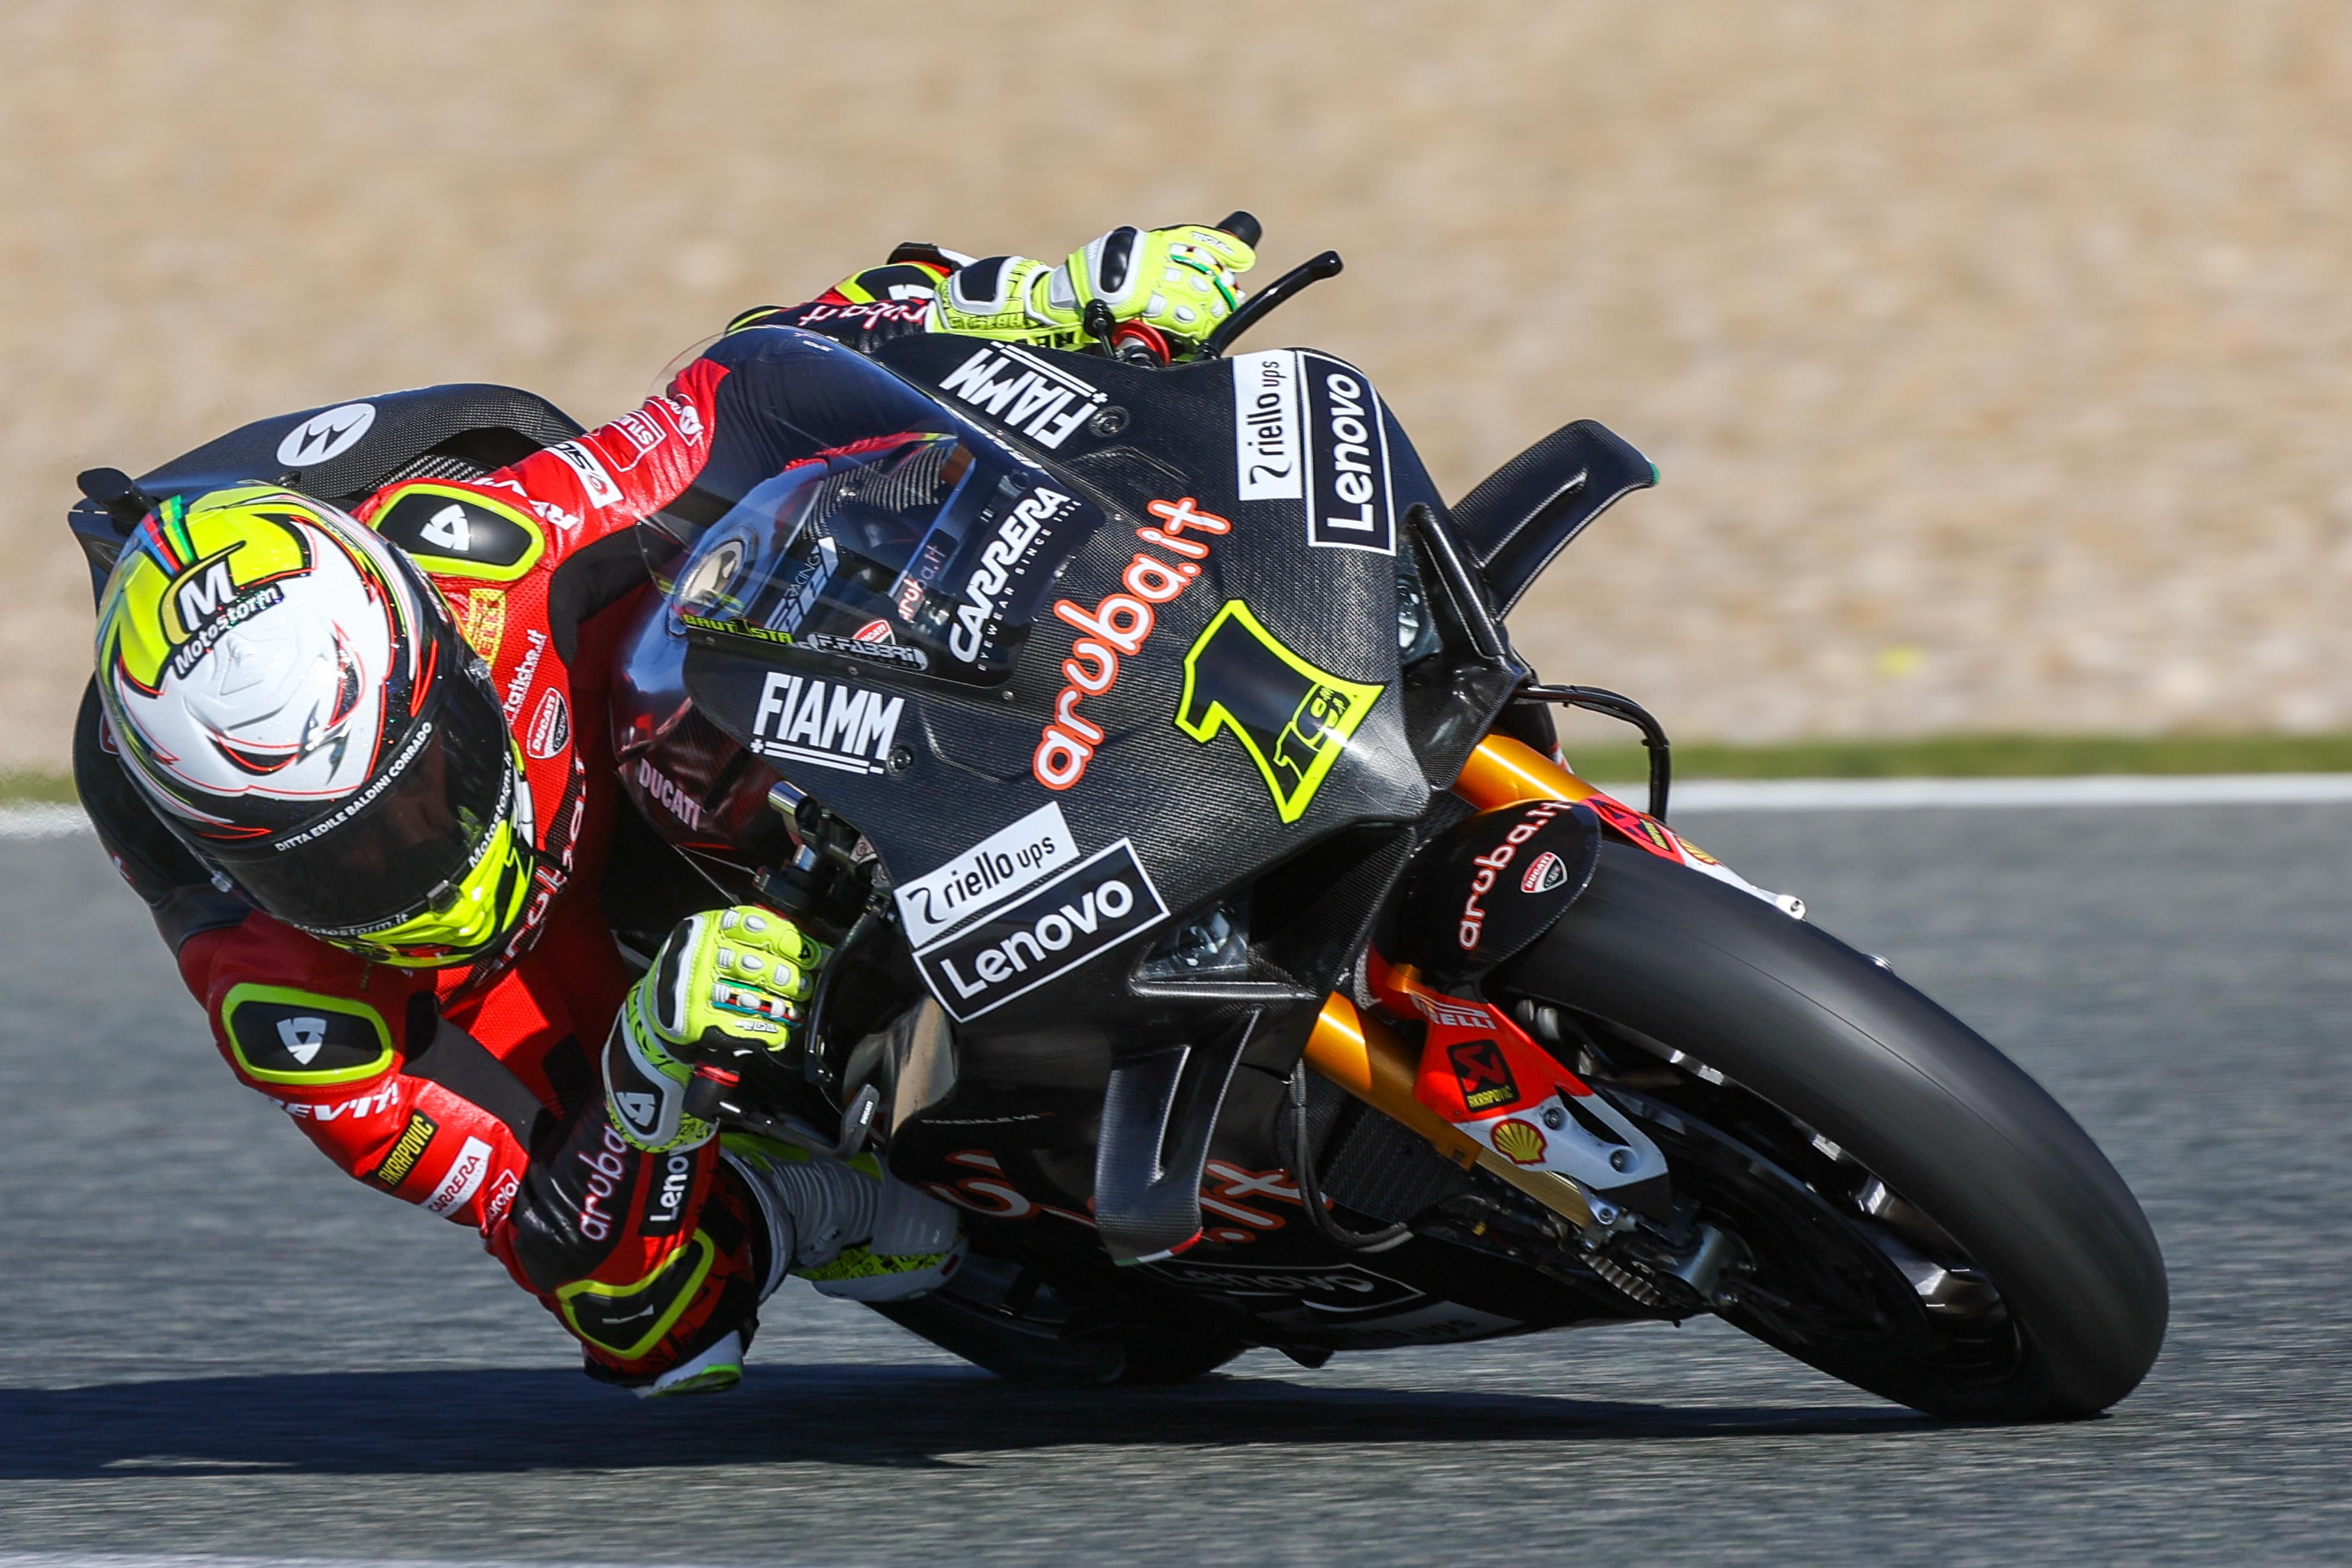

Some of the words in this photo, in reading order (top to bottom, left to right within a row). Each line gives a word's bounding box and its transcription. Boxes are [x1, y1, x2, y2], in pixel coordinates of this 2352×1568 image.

[939, 348, 1097, 450] FIAMM
[1247, 392, 1284, 456] riello
[1262, 360, 1288, 387] ups
[1326, 374, 1375, 532] Lenovo
[948, 487, 1071, 663] CARRERA
[977, 587, 1015, 671] EYEWEAR
[1014, 528, 1052, 575] SINCE
[174, 587, 282, 675] Motostorm
[1033, 497, 1232, 790] aruba.it
[532, 695, 556, 753] DUCATI
[753, 672, 905, 760] FIAMM
[1174, 599, 1385, 824] 1
[275, 833, 311, 852] DITTA
[310, 812, 348, 838] EDILE
[344, 774, 393, 816] BALDINI
[388, 721, 433, 778] CORRADO
[468, 751, 513, 868] Motostorm.it
[638, 758, 702, 832] DUCATI
[943, 851, 1014, 908] riello
[1017, 836, 1055, 870] ups
[1458, 800, 1571, 951] aruba.it
[1526, 853, 1553, 889] DUCATI
[940, 879, 1134, 999] Lenovo
[428, 1155, 481, 1212] CARRERA
